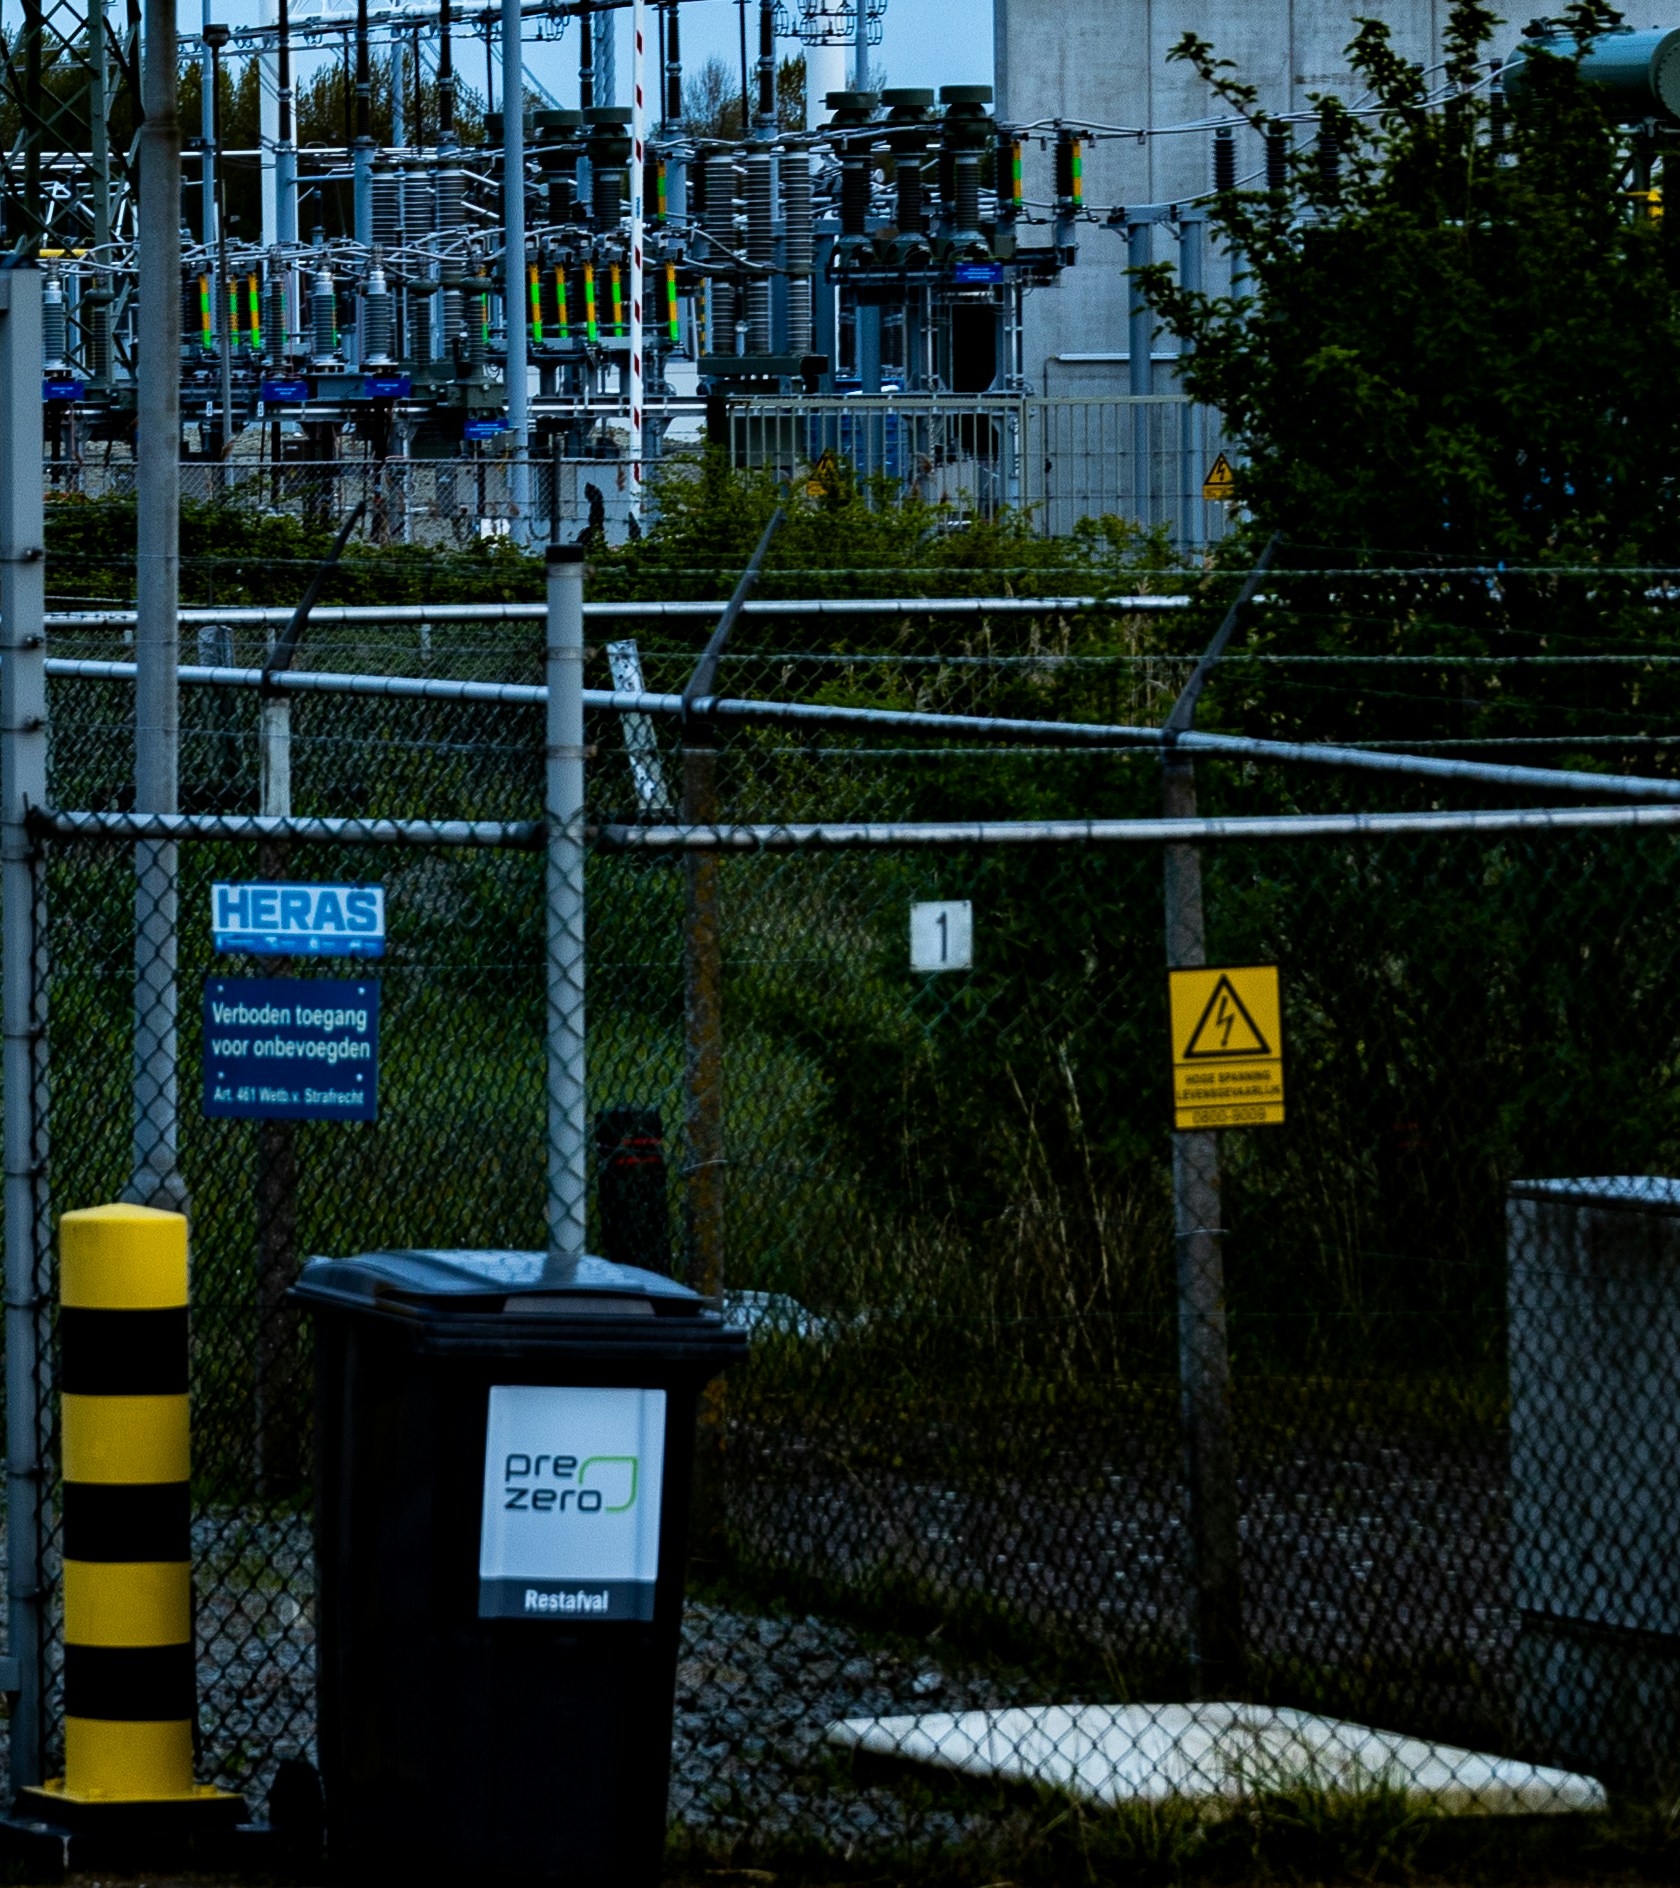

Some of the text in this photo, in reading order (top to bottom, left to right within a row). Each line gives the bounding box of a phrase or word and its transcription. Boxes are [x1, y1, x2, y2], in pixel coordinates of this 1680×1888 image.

[218, 889, 377, 932] HERAS
[935, 912, 947, 962] 1
[212, 1001, 368, 1032] Verboden toegang
[212, 1034, 371, 1065] voor onbevoegden
[304, 1087, 365, 1106] Strafrecht
[505, 1453, 577, 1482] pre
[504, 1487, 602, 1513] zero
[525, 1590, 608, 1612] Restafval
